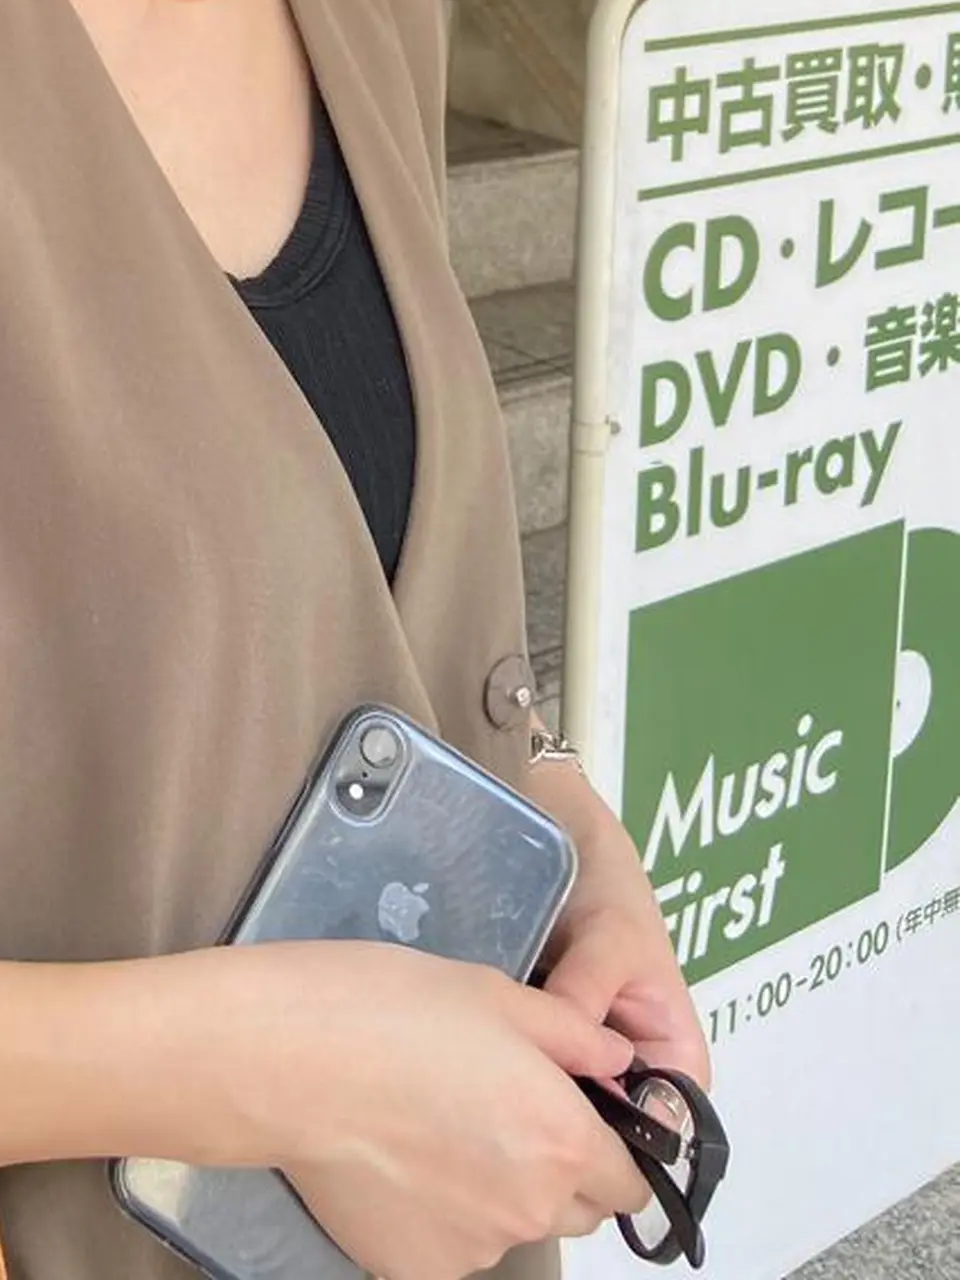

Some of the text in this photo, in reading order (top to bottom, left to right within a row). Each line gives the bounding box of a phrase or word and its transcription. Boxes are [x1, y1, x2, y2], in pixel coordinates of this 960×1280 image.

[647, 33, 960, 162] 中古買取・
[635, 420, 902, 554] Blu-ray
[643, 715, 843, 872] Music
